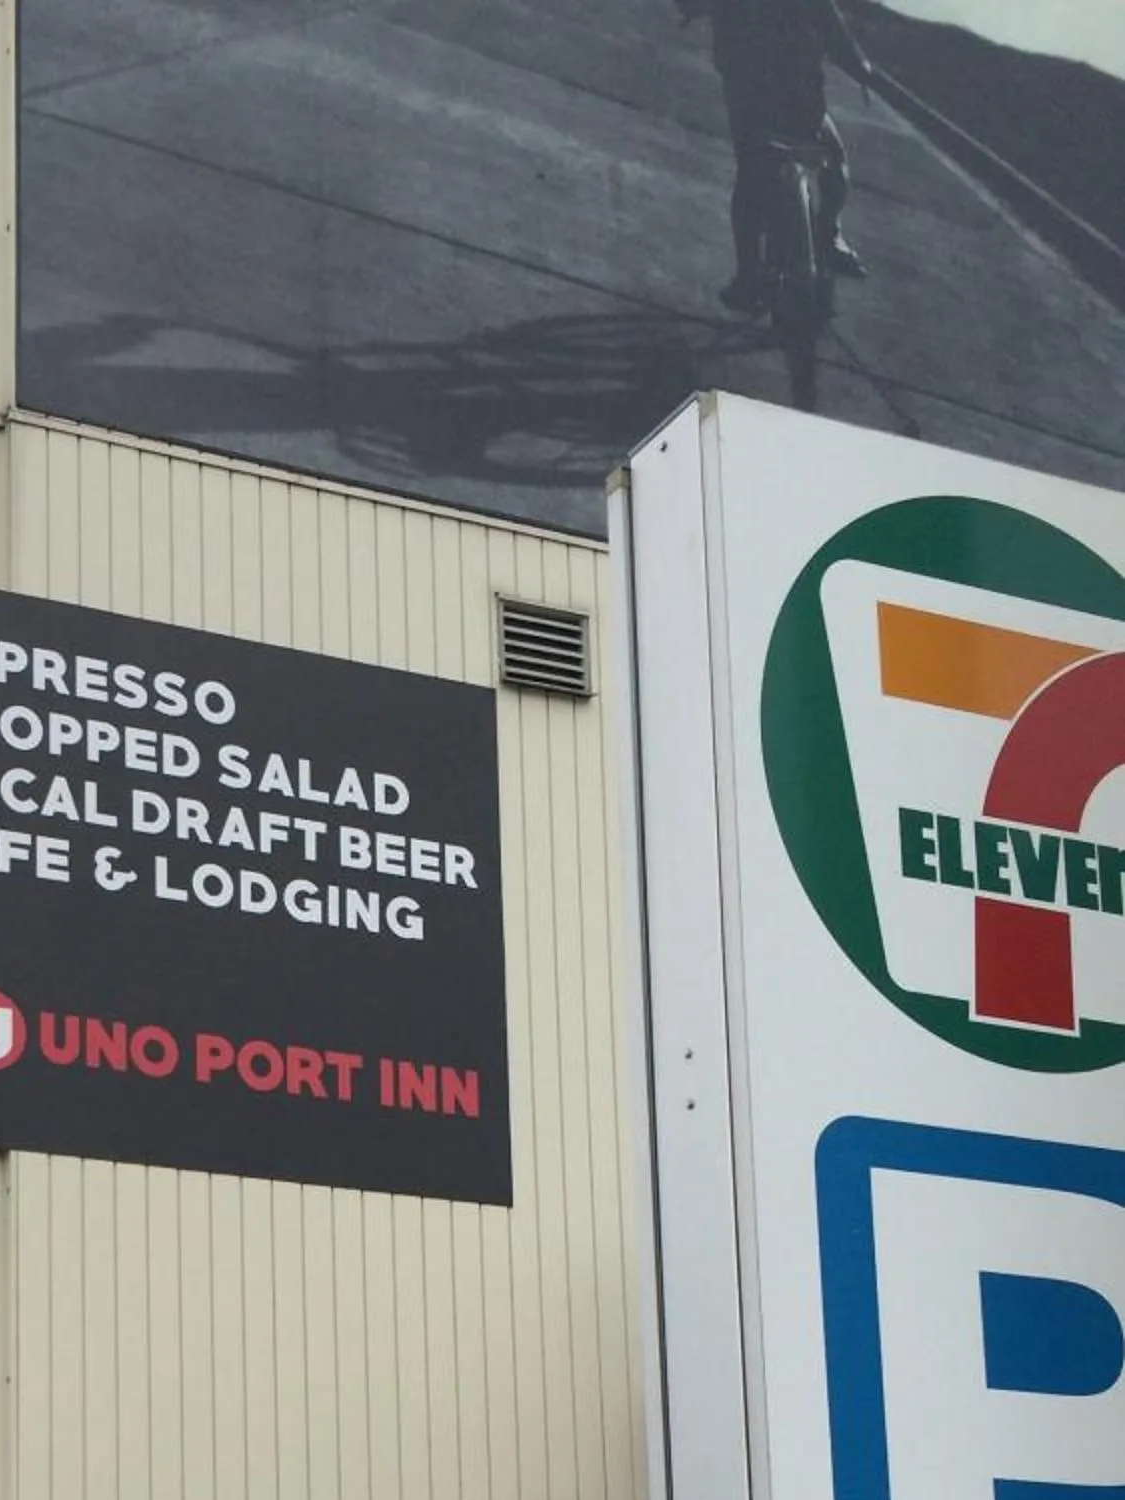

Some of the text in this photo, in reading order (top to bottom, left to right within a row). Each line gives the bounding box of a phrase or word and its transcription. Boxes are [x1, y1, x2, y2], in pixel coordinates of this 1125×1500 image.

[218, 744, 410, 815] SALAD
[131, 789, 328, 862] DRAFT
[339, 825, 478, 889] BEER
[94, 845, 138, 892] &
[154, 855, 424, 941] LODGING
[39, 1013, 179, 1077] UNO
[196, 1034, 362, 1101] PORT
[380, 1058, 480, 1117] INN
